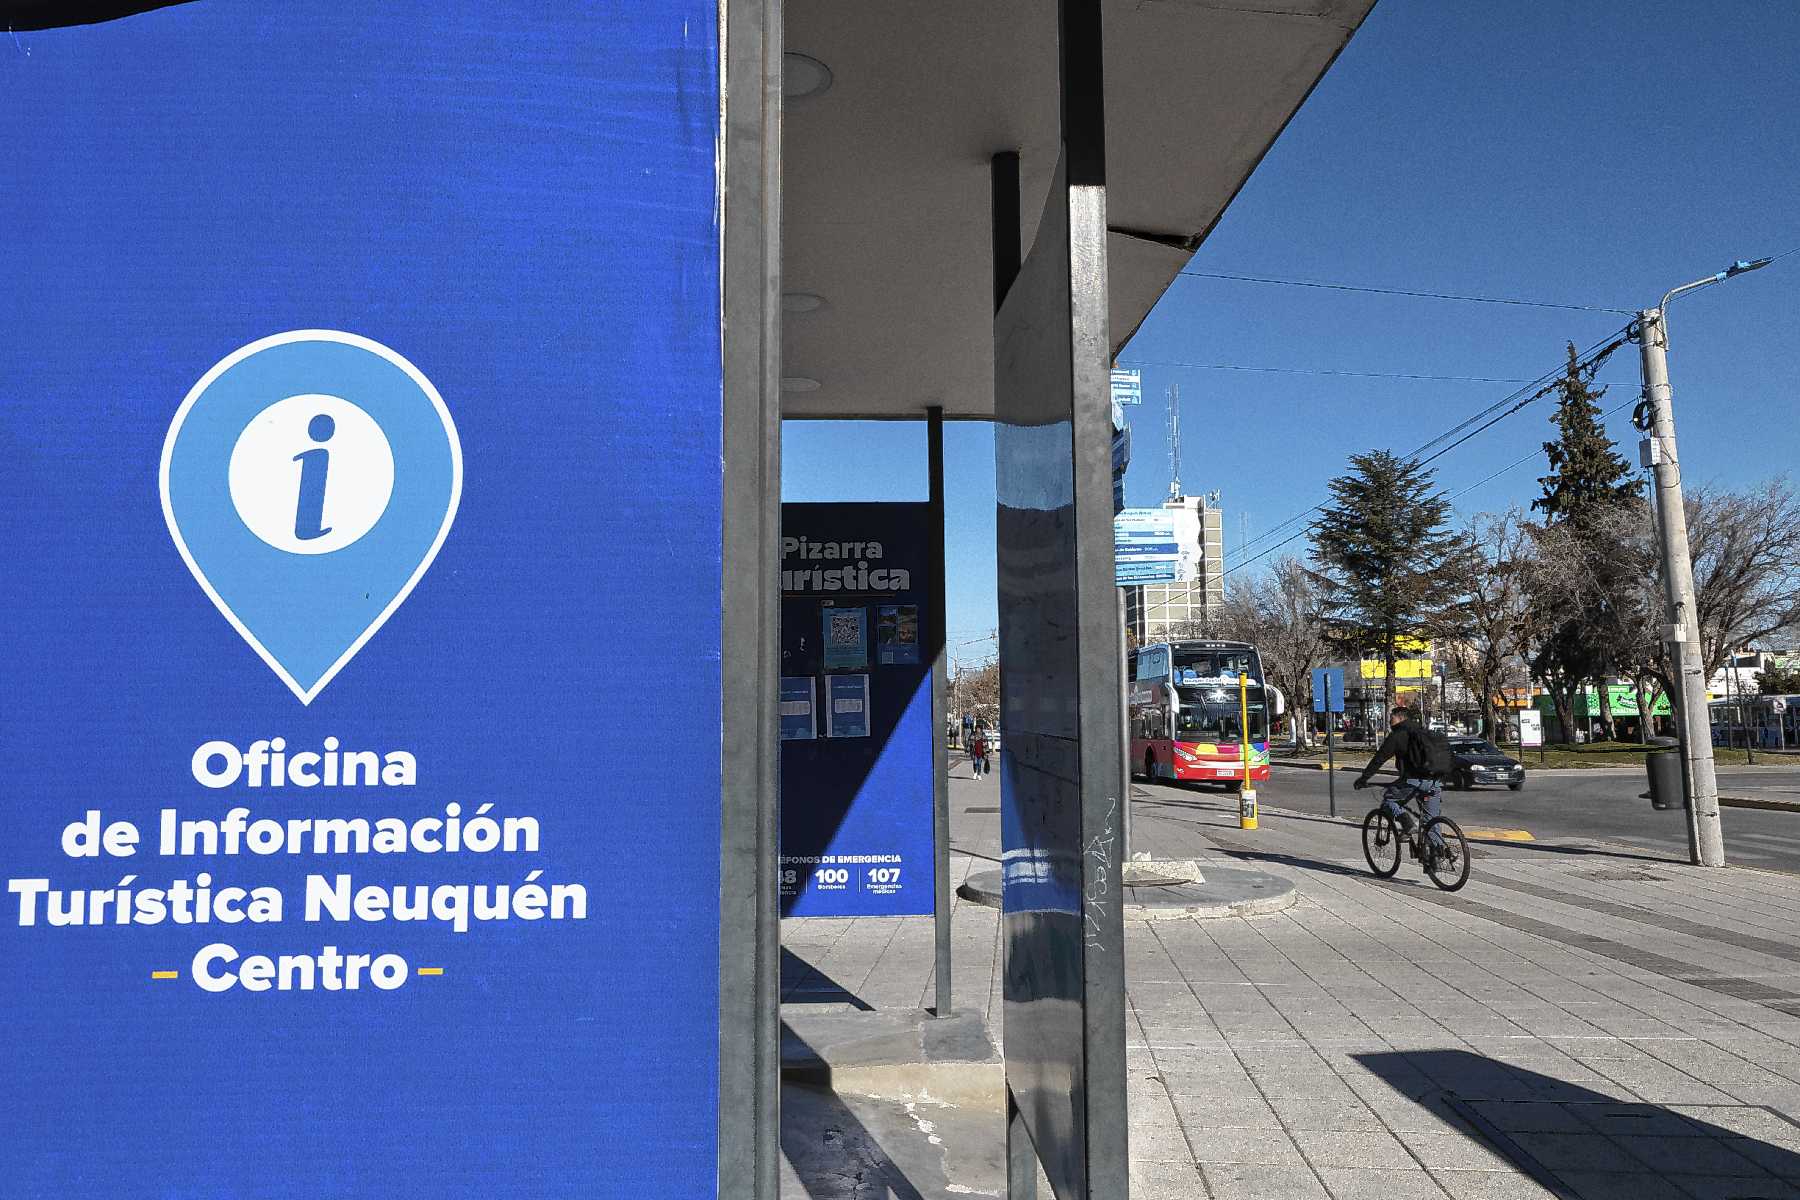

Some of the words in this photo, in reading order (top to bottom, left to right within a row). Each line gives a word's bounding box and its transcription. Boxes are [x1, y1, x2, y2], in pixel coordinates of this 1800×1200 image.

[783, 536, 882, 559] Pizarra
[191, 736, 417, 789] Oficina
[61, 810, 140, 858] de
[159, 802, 540, 856] Información
[815, 869, 848, 883] 100
[822, 855, 834, 864] DE
[837, 855, 901, 864] EMERGENCIA
[868, 868, 900, 882] 107
[8, 872, 283, 927] Turística
[304, 870, 588, 932] Neuquén
[192, 943, 409, 993] Centro
